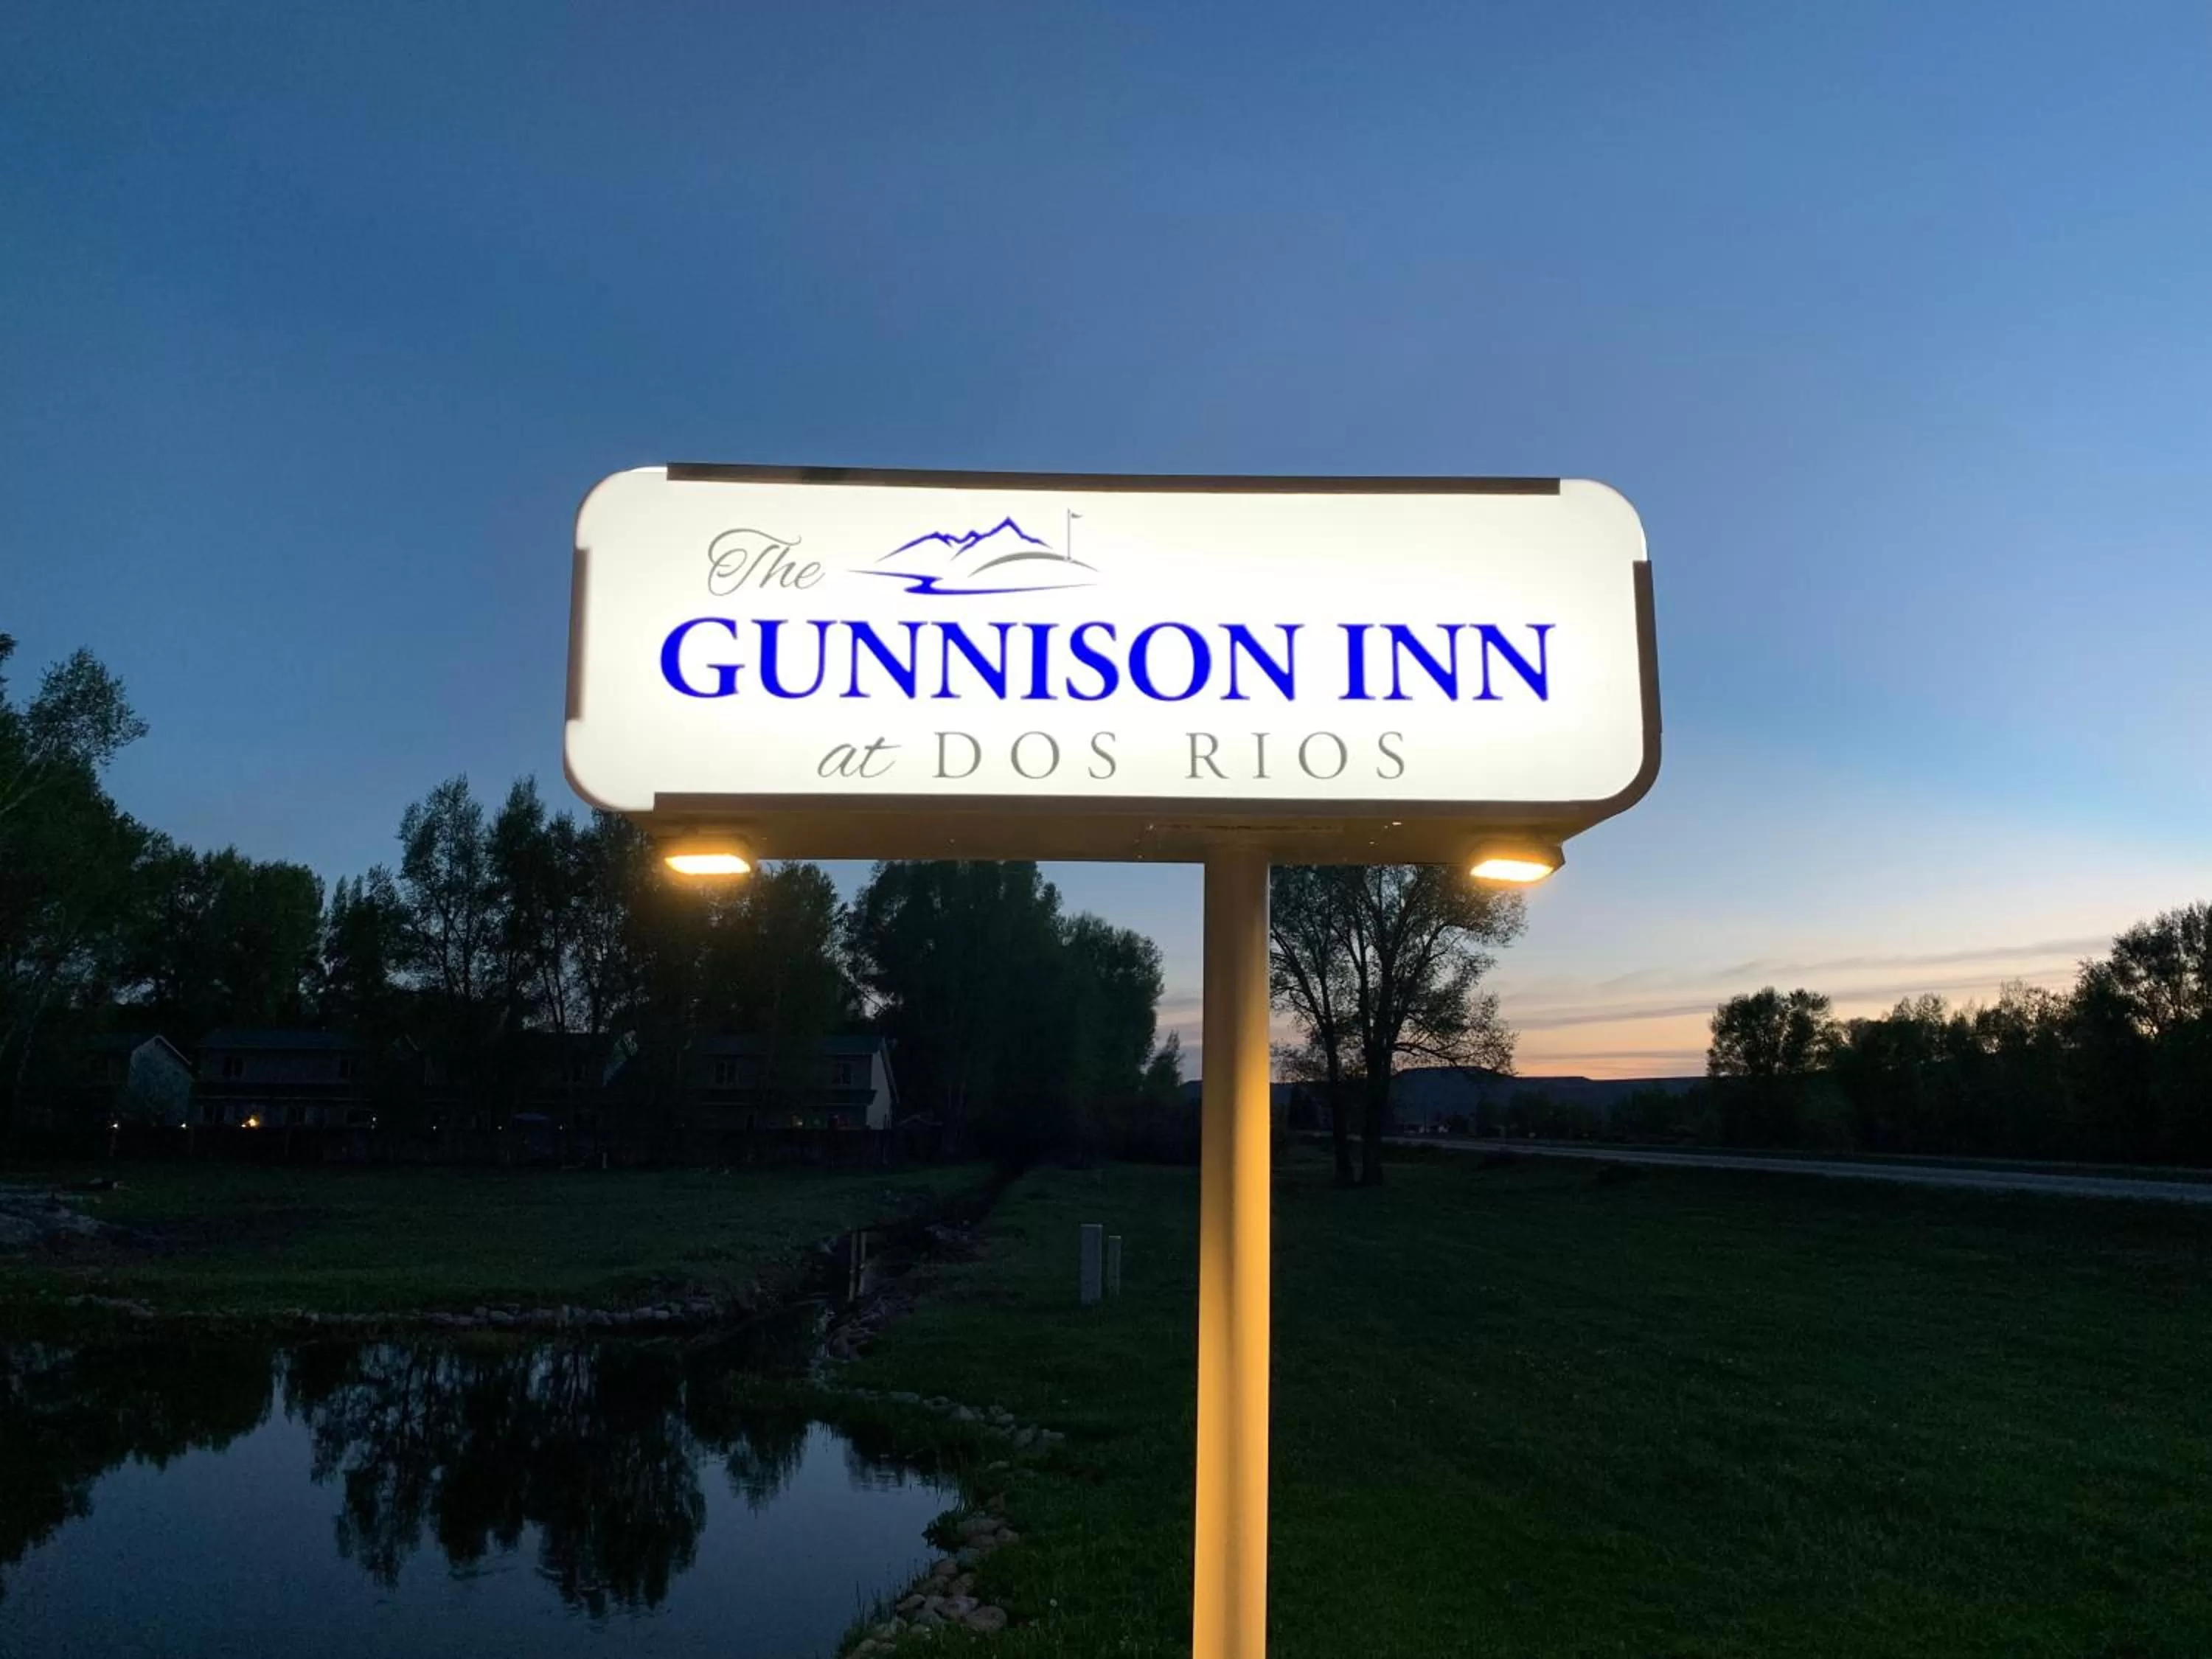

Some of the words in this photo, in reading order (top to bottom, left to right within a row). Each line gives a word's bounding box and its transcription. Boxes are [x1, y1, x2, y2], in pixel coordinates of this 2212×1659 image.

[708, 529, 822, 596] The
[659, 616, 1305, 703] GUNNISON
[1336, 622, 1557, 703] INN
[817, 737, 897, 779] at
[933, 731, 1117, 780] DOS
[1185, 731, 1406, 780] RIOS
